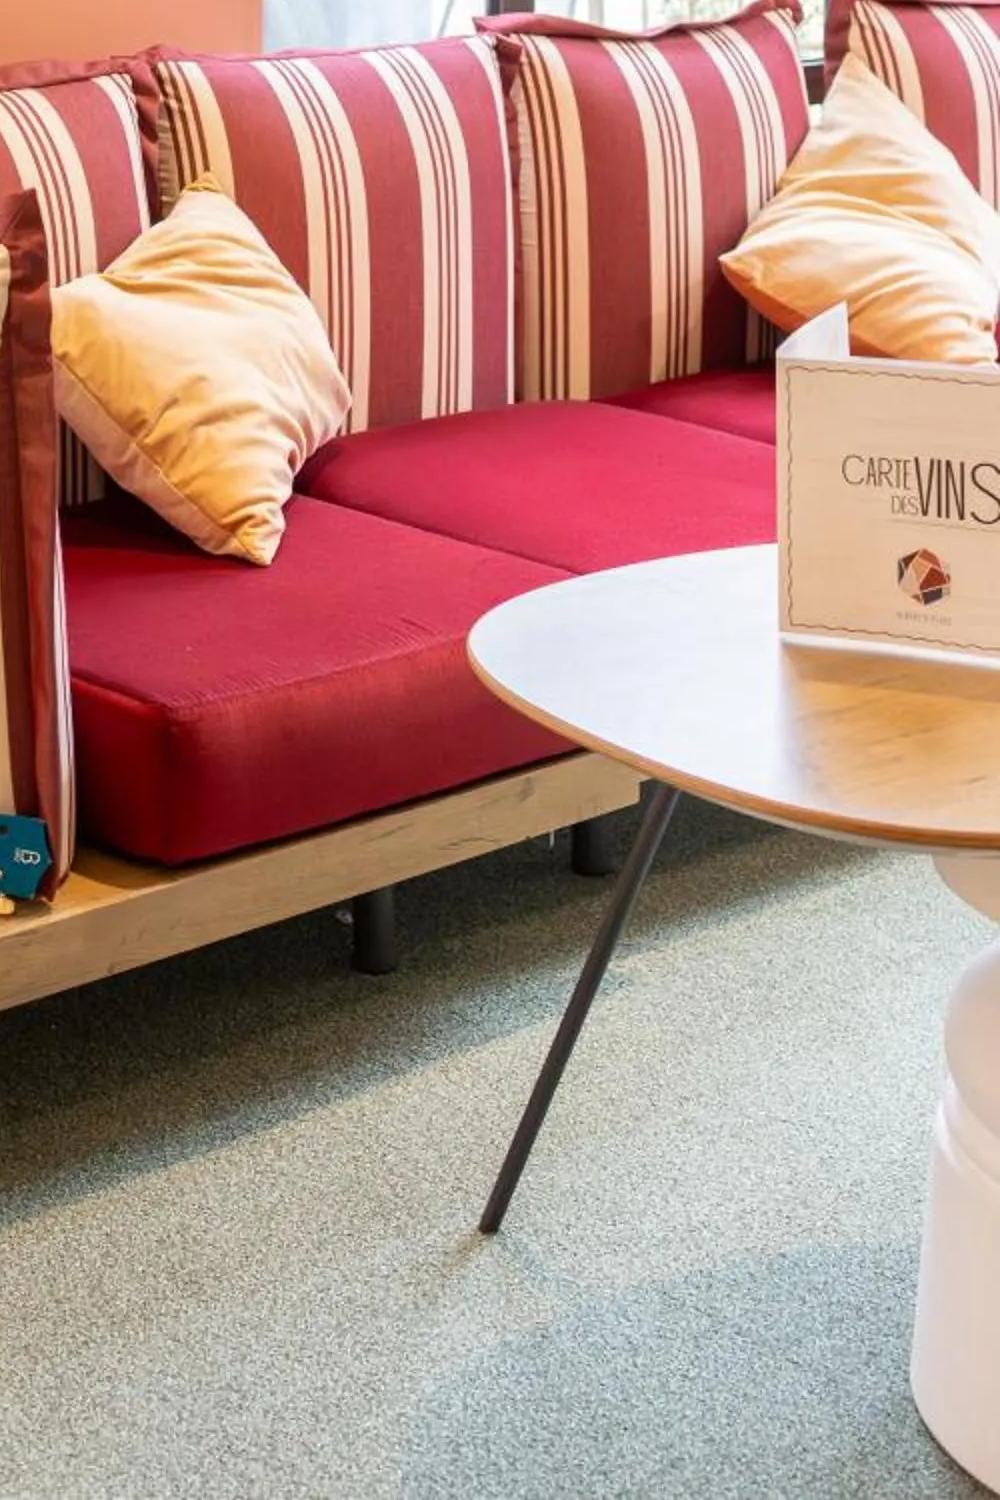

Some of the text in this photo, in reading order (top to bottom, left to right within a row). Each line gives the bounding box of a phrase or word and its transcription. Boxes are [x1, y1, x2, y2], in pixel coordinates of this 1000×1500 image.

[842, 454, 1000, 525] CARTE DES VINS
